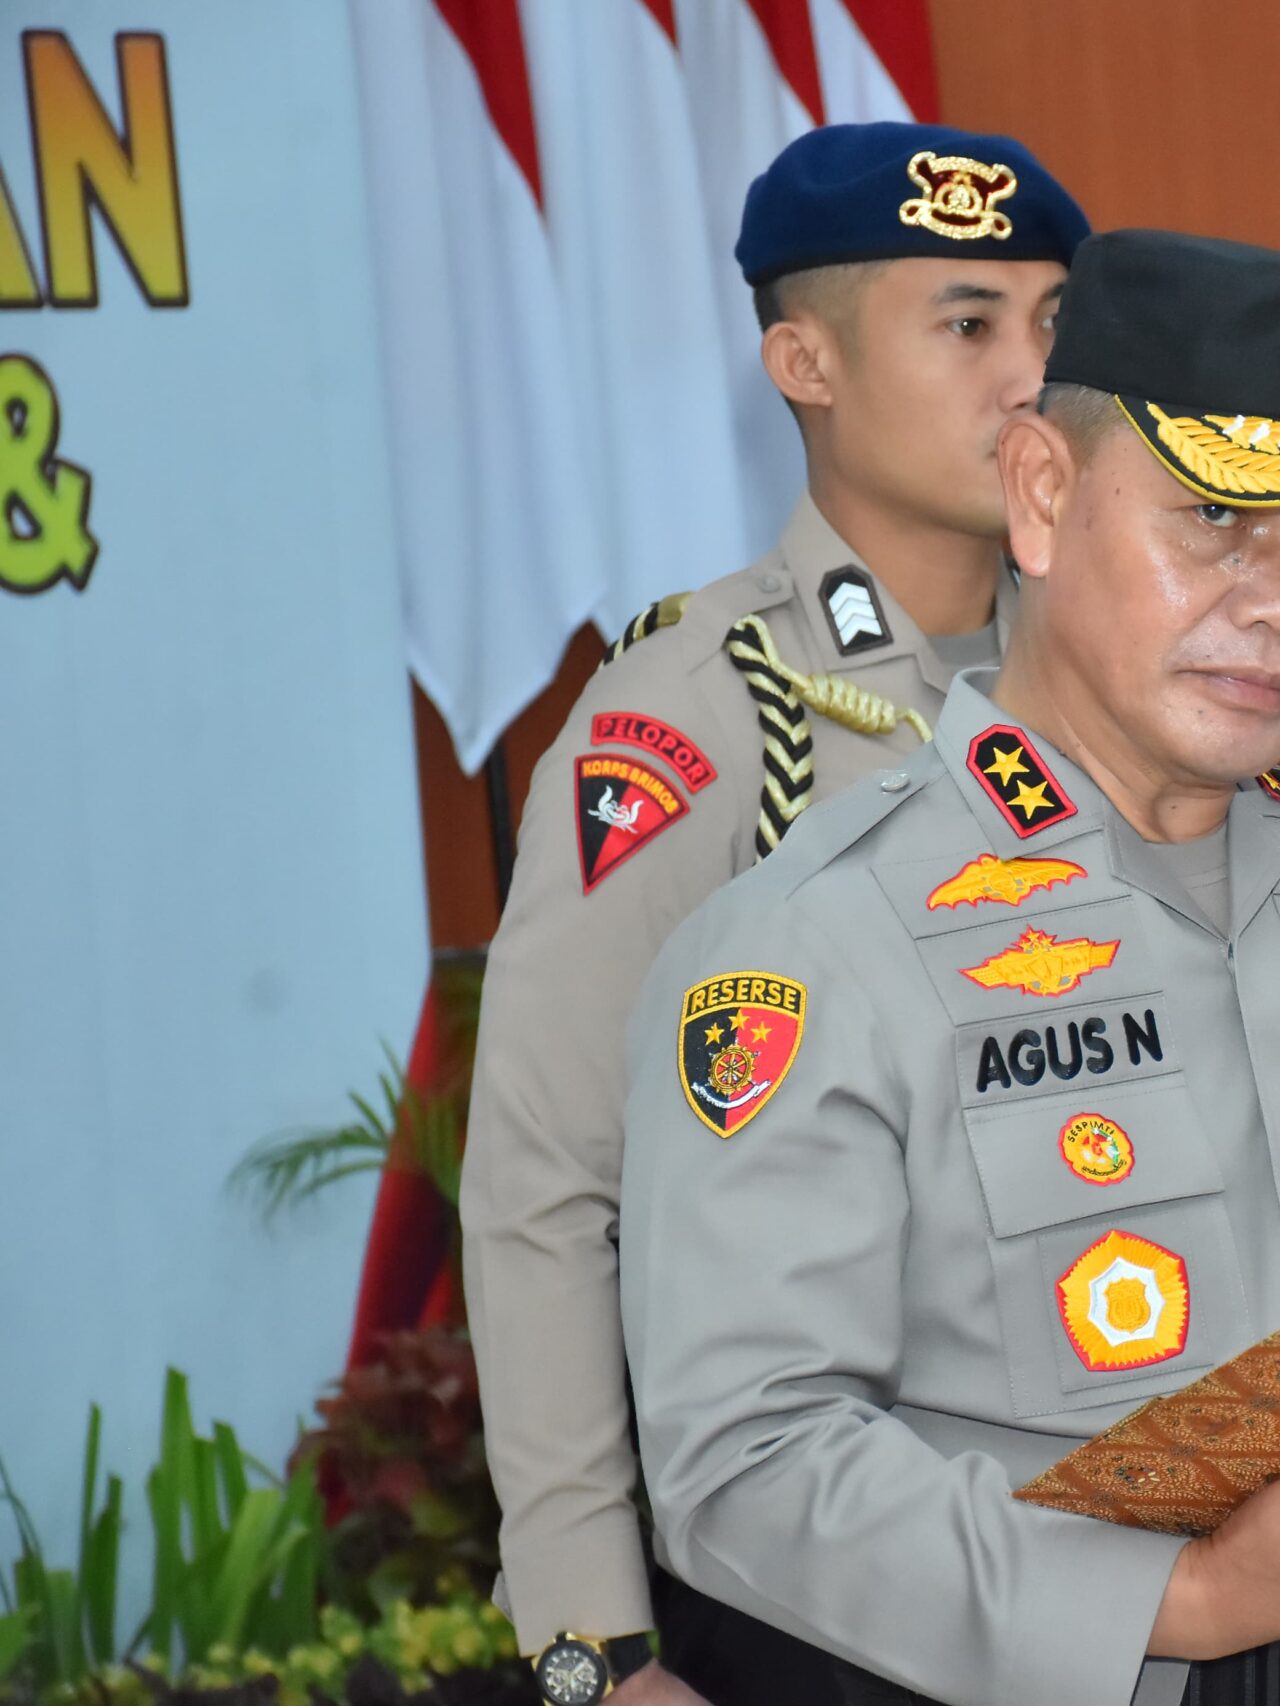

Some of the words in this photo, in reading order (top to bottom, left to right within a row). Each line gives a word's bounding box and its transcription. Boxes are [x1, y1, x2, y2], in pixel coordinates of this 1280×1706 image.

[0, 353, 100, 595] &
[599, 718, 706, 783] PELOPOR
[582, 760, 630, 779] KORPS
[629, 767, 679, 814] BRIMOB
[691, 979, 797, 1014] RESERSE
[976, 1017, 1114, 1093] AGUS
[1122, 1009, 1163, 1066] N
